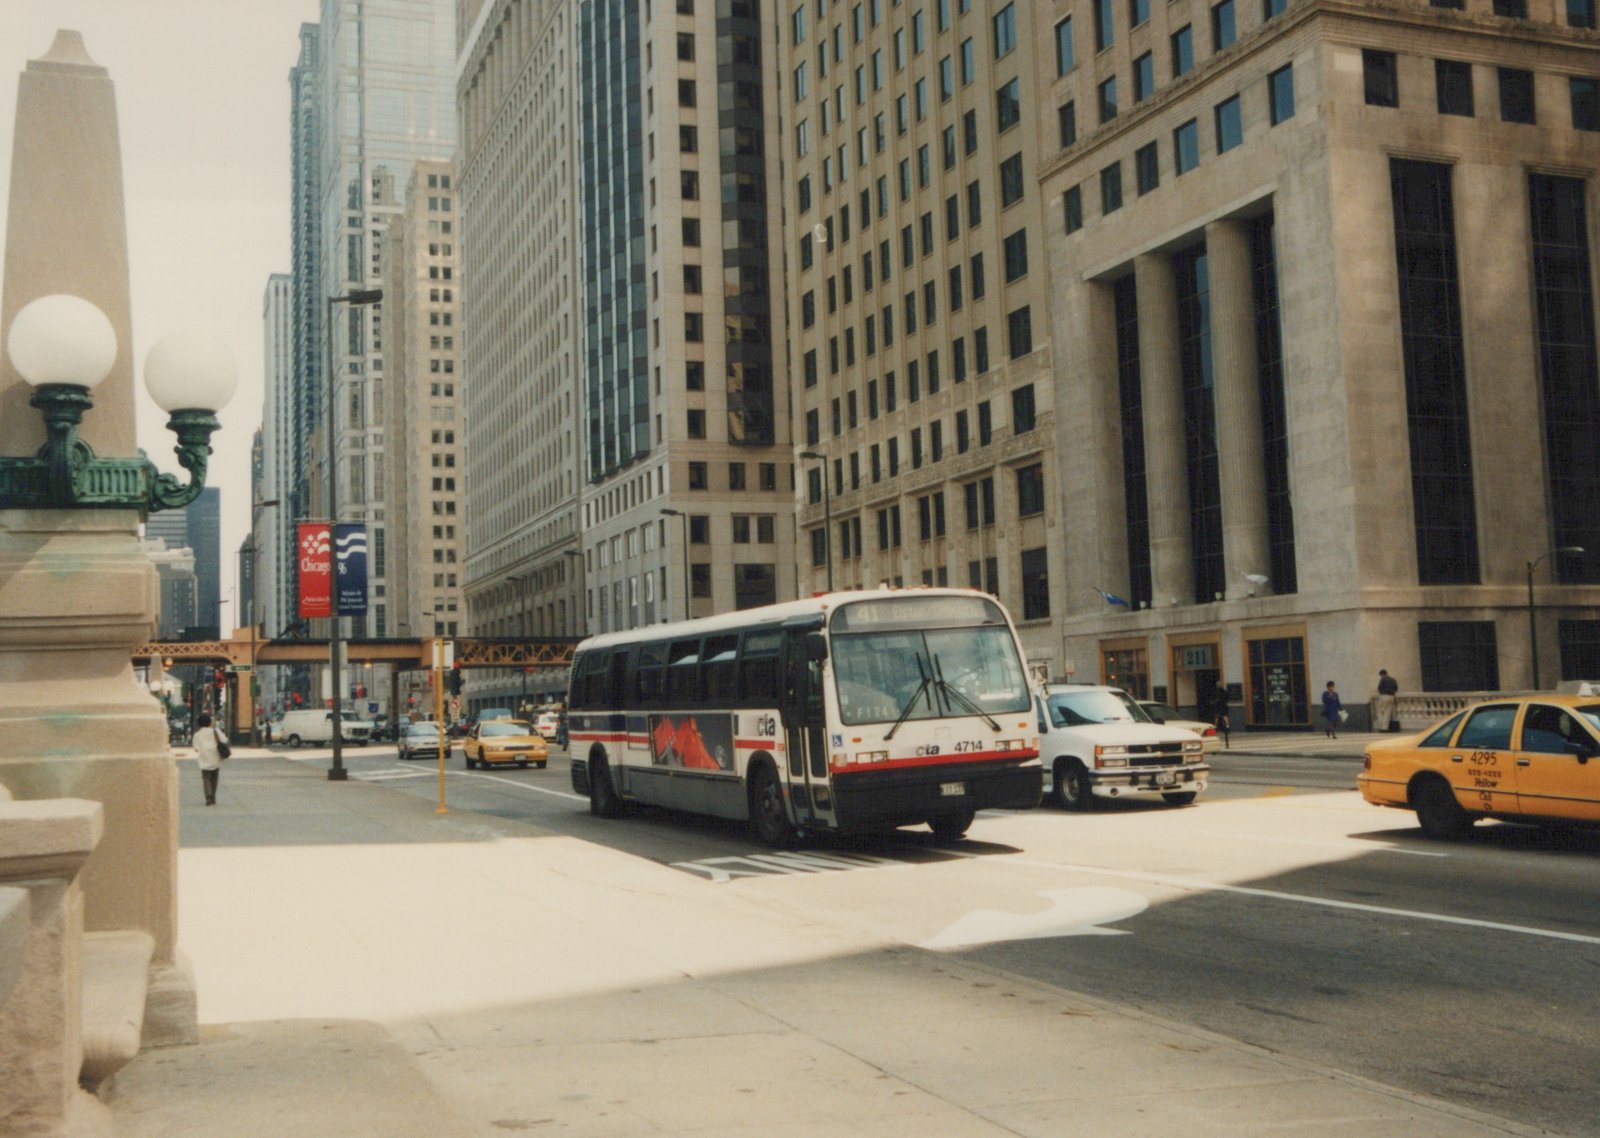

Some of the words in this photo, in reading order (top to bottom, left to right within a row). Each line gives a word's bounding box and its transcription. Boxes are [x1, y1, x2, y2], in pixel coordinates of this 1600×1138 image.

[301, 556, 331, 575] Chicago
[857, 604, 879, 621] 41
[1186, 650, 1207, 665] 211
[915, 744, 940, 757] cta
[954, 740, 983, 753] 4714
[1470, 751, 1497, 766] 4295
